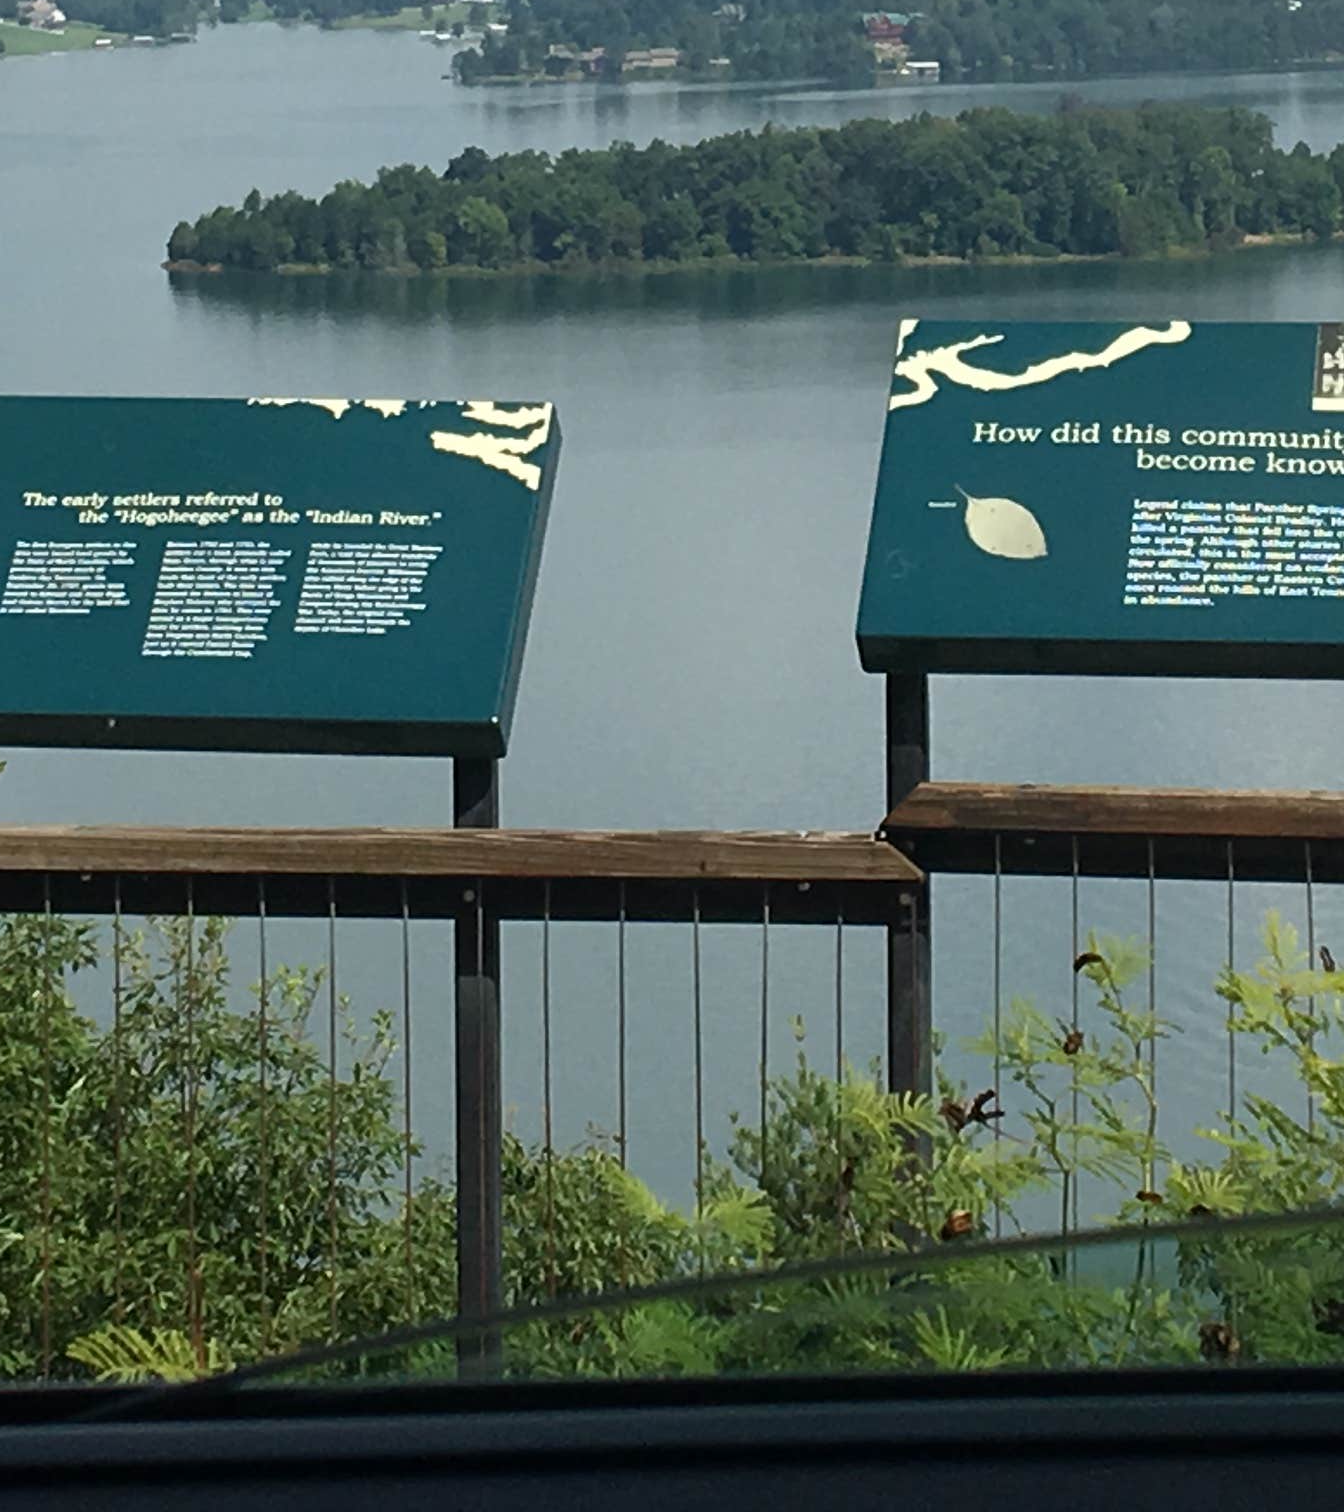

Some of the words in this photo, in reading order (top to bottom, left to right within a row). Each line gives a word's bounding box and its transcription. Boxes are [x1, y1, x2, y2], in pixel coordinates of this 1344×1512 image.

[974, 423, 1041, 442] How
[1051, 423, 1099, 443] did
[1112, 424, 1170, 443] this
[1136, 449, 1255, 470] become
[24, 492, 57, 505] The
[62, 492, 108, 509] early
[113, 492, 180, 506] settlers
[185, 492, 258, 505] referred
[264, 494, 282, 505] to
[79, 508, 108, 522] the
[242, 513, 263, 522] as
[270, 509, 299, 522] the
